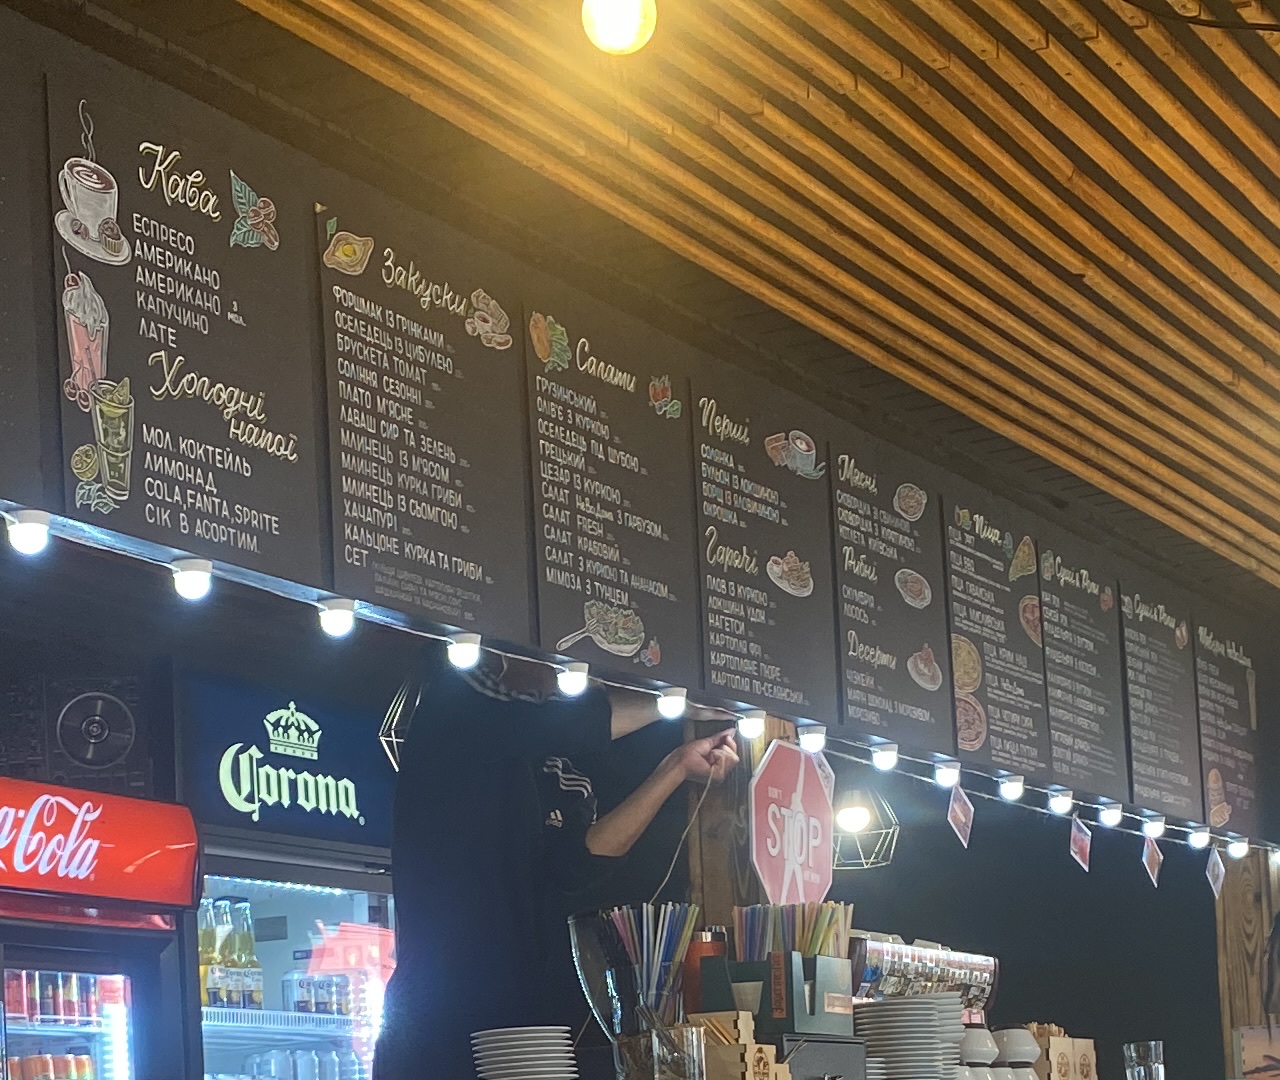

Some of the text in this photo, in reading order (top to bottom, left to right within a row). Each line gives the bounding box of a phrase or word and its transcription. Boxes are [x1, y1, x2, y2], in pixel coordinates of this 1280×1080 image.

[138, 140, 221, 222] Кава
[132, 213, 195, 255] ЕСПРЕСО
[134, 239, 220, 290] АМЕРИКАНО
[381, 248, 472, 316] Закуски
[136, 265, 221, 315] АМЕРИКАНО
[136, 290, 209, 334] КАПУЧИНО
[140, 317, 177, 348] ЛАТЕ
[332, 285, 444, 350] ФОРШМАК ІЗ ГРІНКАМИ
[335, 310, 453, 374] ОСЕЛЕДЕЦЬ ІЗ ЦИБУЛЕЮ
[337, 333, 427, 385] БРУСКЕТА ТОМАТ
[338, 357, 422, 406] СОЛІННЯ СЕЗОННІ
[576, 337, 636, 392] Салати
[148, 350, 267, 424] Холодні
[339, 380, 414, 425] ПЛАТО М'ЯСНЕ
[536, 375, 597, 415] ГРУЗИНСЬКИЙ
[230, 418, 298, 463] напої
[340, 405, 456, 464] ЛАВАШ СИР ТА ЗЕЛЕНЬ
[537, 418, 639, 472] ОСЕЛЕДЕЦЬ ПІД ШУБОЮ
[567, 409, 573, 424] З
[575, 413, 610, 440] КУРКОЮ
[699, 397, 750, 446] Перші
[143, 424, 252, 477] МОЛ. КОКТЕЙЛЬ
[145, 452, 217, 494] ЛИМОНАД
[340, 427, 450, 484] МЛИНЕЦЬ ІЗ М'ЯСОМ
[539, 439, 586, 472] ГРЕЦЬКИЙ
[341, 452, 463, 509] МЛИНЕЦЬ КУРКА ГРИБИ
[342, 475, 458, 530] МЛИНЕЦЬ ІЗ СЬОМГОЮ
[540, 461, 620, 504] ЦЕЗАР ІЗ КУРКОЮ
[145, 503, 261, 553] СІК В АСОРТИМ.
[343, 499, 398, 532] ХАЧАПУРІ
[542, 482, 570, 505] САЛАТ
[617, 510, 623, 525] З
[624, 512, 662, 538] ГАРБУЗОМ
[543, 503, 604, 537] САЛАТ FRESH
[973, 513, 1002, 546] Піца
[344, 522, 483, 581] КАЛЬЦОНЕ КУРКА ТА ГРИБИ
[345, 544, 369, 568] СЕТ
[544, 524, 620, 562] САЛАТ КРАБОВИЙ
[545, 546, 668, 598] САЛАТ З КУРКОЮ ТА АНАНАСОМ
[546, 567, 629, 607] МІМОЗА З ТУНЦЕМ
[708, 613, 746, 636] НАГЕТСИ
[747, 606, 767, 624] УДОН
[709, 631, 748, 653] КАРТОПЛЯ
[710, 651, 781, 682] КАРТОПЛЯНЕ ПЮРЕ
[847, 629, 897, 669] Десерти
[711, 670, 750, 692] КАРТОПЛЯ
[220, 742, 359, 821] Corona
[767, 803, 822, 868] STOP
